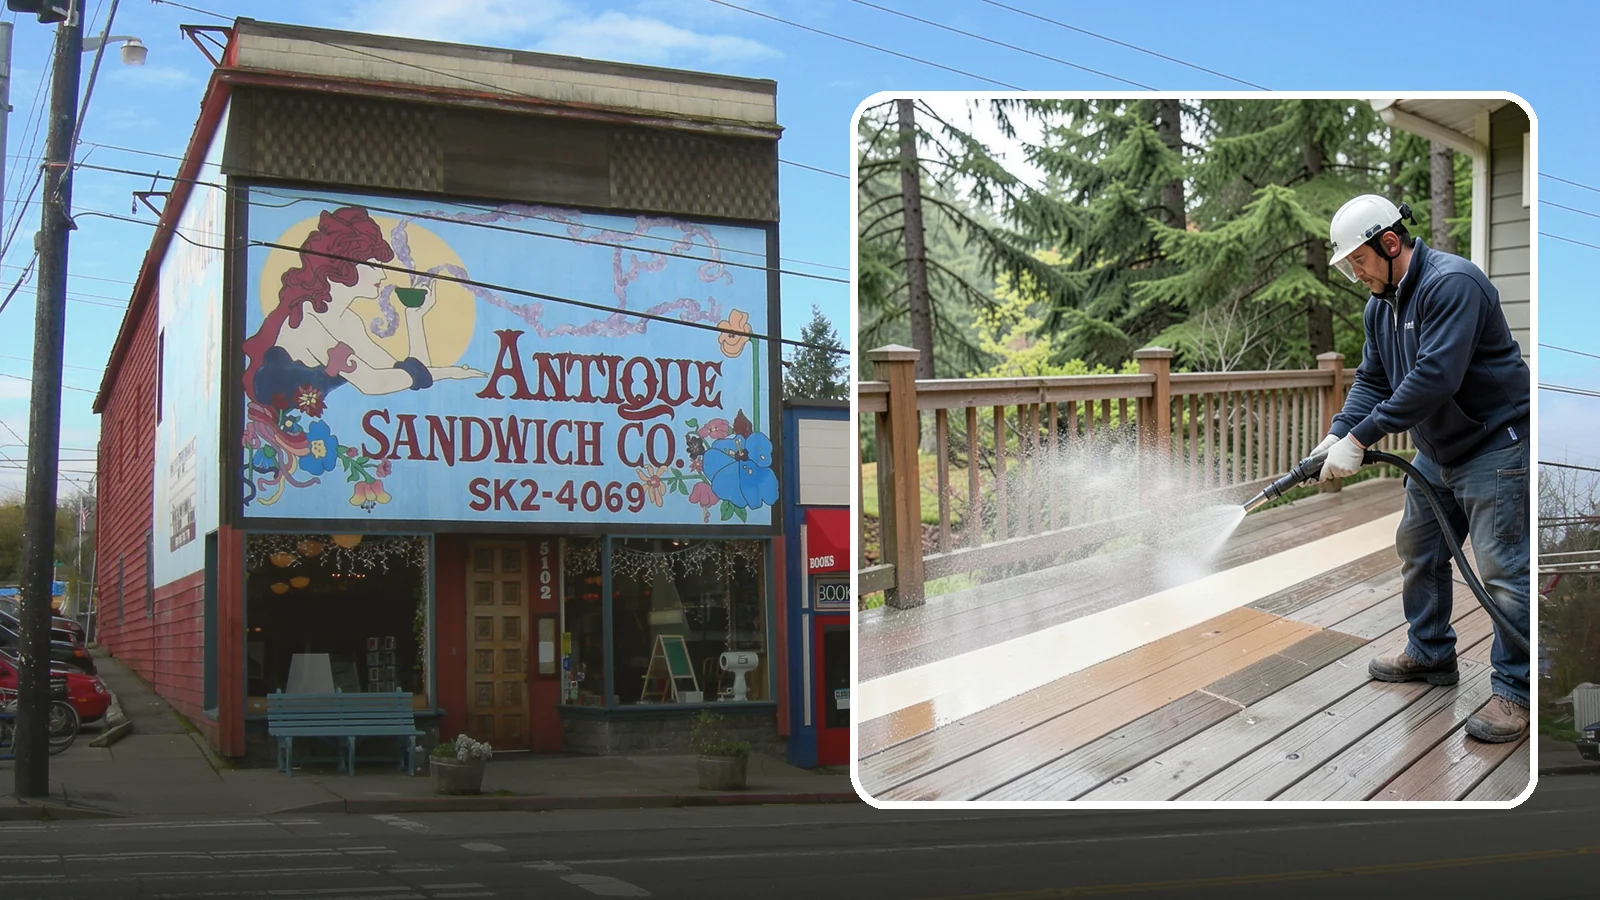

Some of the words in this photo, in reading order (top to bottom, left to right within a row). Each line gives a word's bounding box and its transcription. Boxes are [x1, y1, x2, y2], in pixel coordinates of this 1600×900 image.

[475, 329, 723, 421] ANTIQUE
[361, 408, 605, 468] SANDWICH
[617, 422, 685, 469] CO.
[468, 476, 646, 514] SK2-4069
[539, 541, 552, 600] 5102
[809, 554, 835, 569] BOOKS
